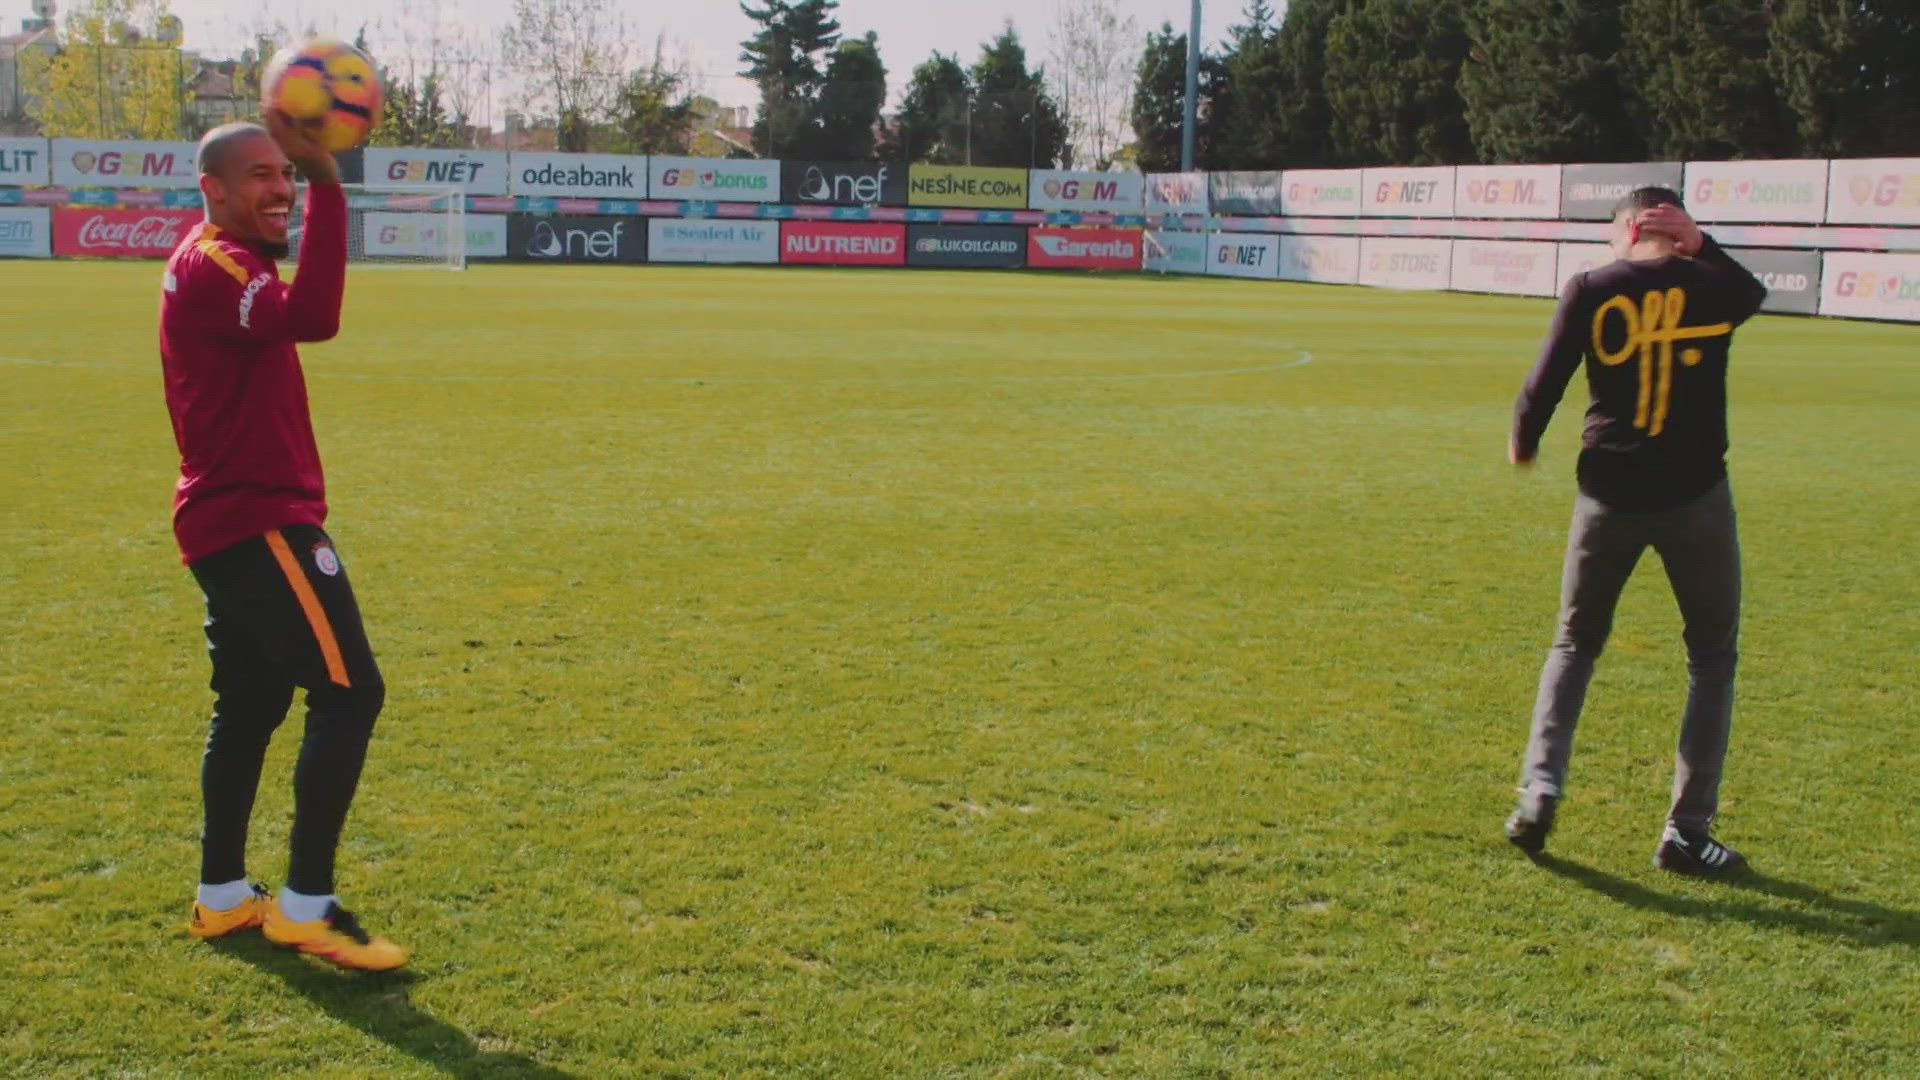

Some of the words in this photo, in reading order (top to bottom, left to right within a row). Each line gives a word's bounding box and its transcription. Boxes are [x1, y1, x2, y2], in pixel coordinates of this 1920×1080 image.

[98, 151, 175, 176] GSM
[387, 160, 484, 183] GSNET
[522, 163, 634, 189] odeabank
[663, 168, 695, 186] GS
[713, 169, 768, 190] bonus
[834, 167, 887, 201] nef
[1062, 180, 1118, 201] GSM
[1695, 179, 1729, 204] GS
[1750, 181, 1813, 205] bonus
[566, 222, 623, 258] nef
[677, 226, 734, 241] Sealed
[741, 227, 766, 242] Air
[787, 235, 896, 254] NUTREND
[937, 239, 1018, 253] LUKOILCARD
[1055, 237, 1134, 258] Garenta
[1218, 245, 1267, 268] GSNET
[1836, 271, 1876, 298] GS
